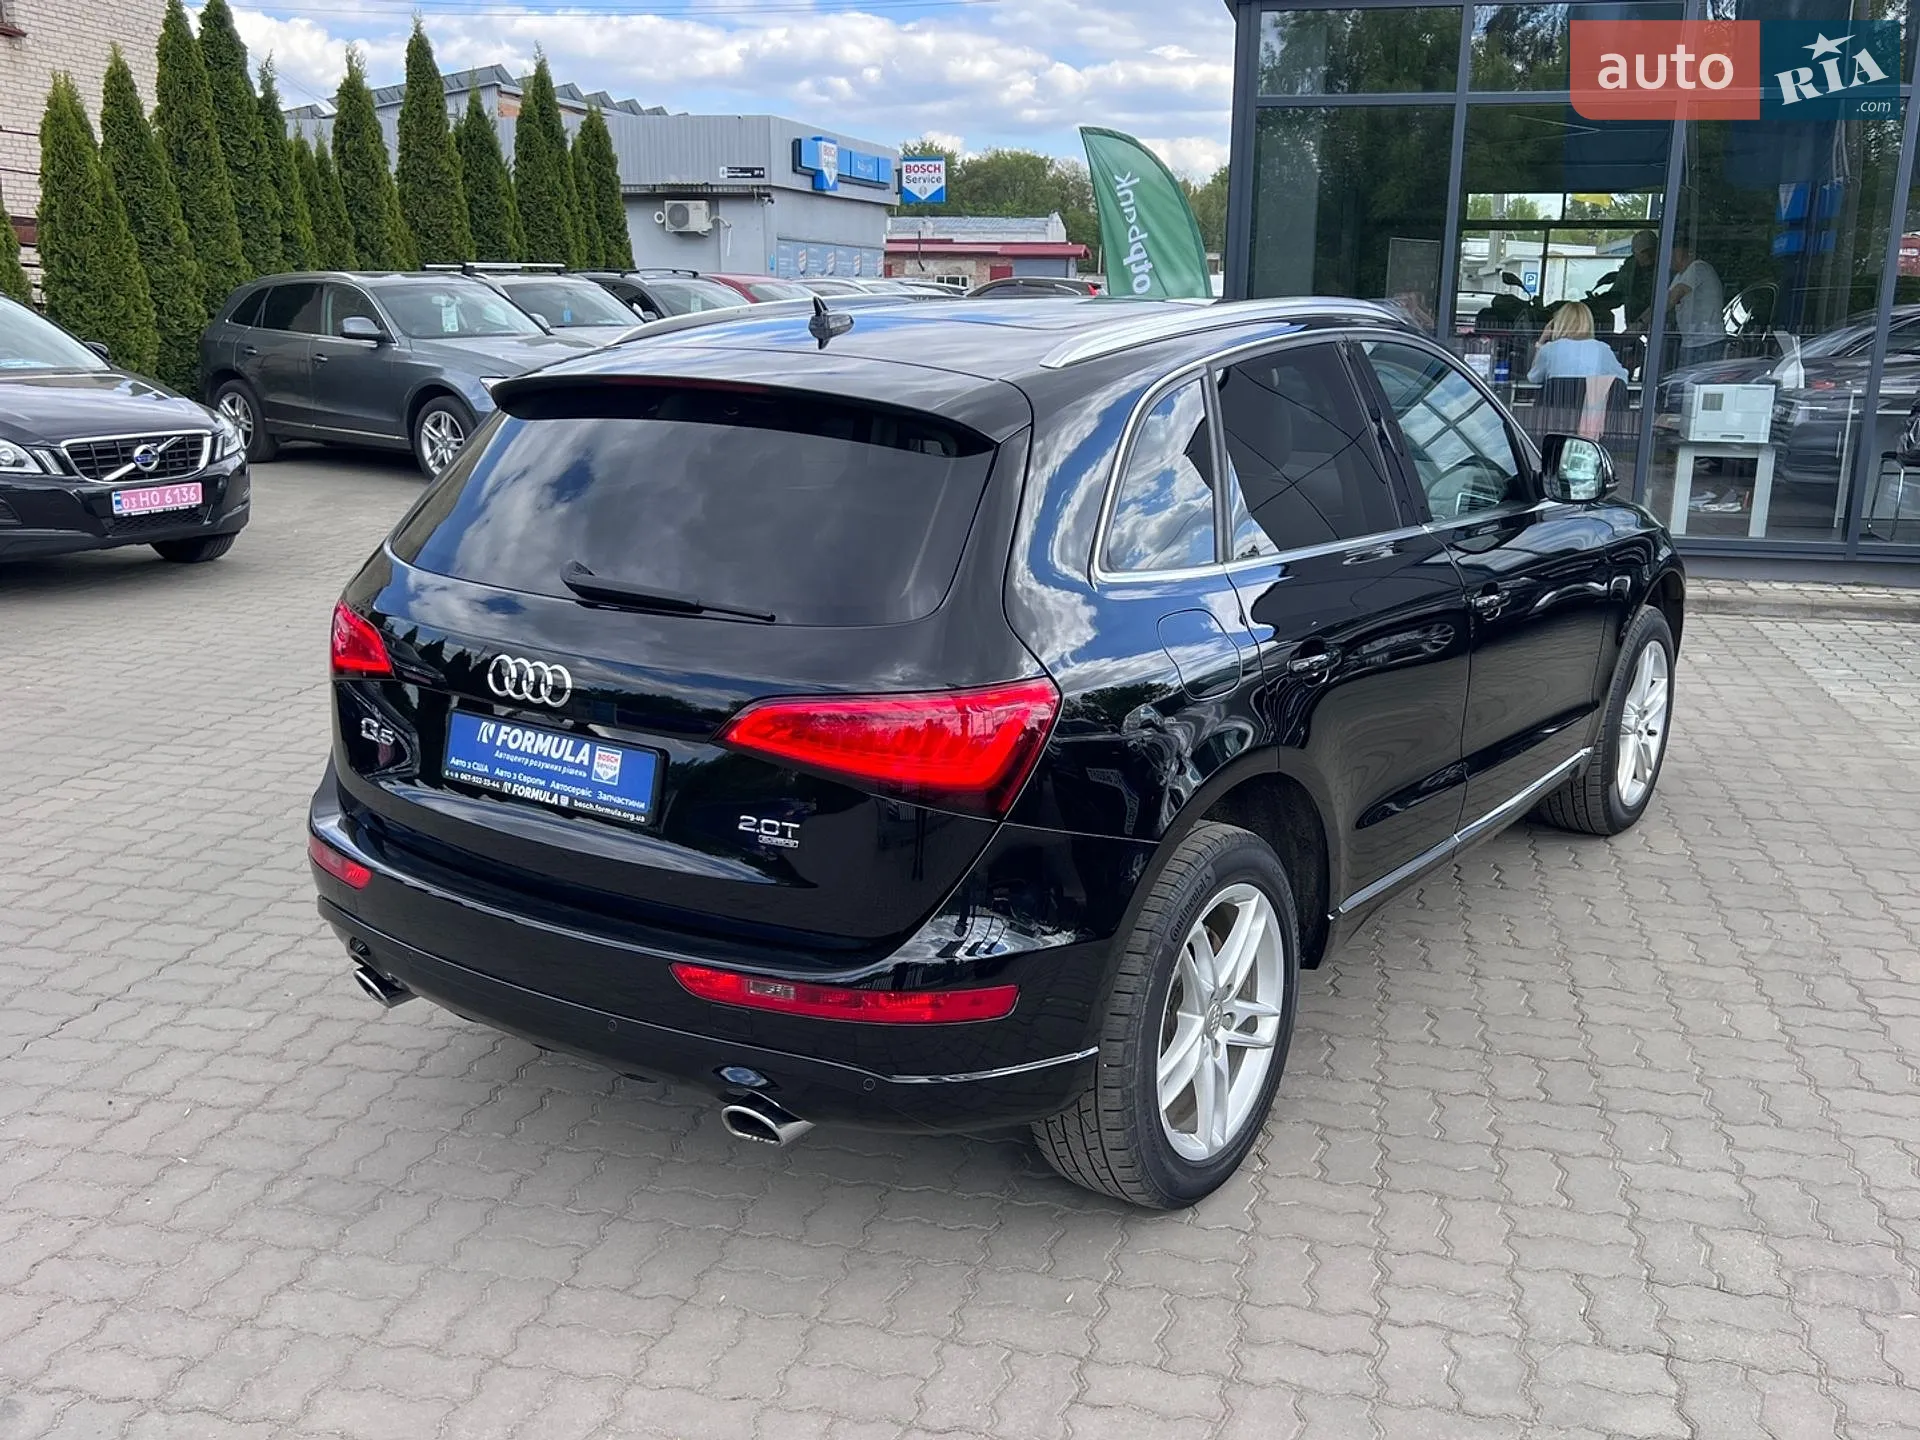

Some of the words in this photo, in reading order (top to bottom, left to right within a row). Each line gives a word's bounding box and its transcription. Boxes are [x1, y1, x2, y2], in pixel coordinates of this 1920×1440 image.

[905, 164, 941, 174] BOSCH
[905, 174, 942, 184] Service
[122, 497, 138, 509] 03
[164, 486, 197, 504] 6136
[361, 717, 395, 746] Q5
[496, 725, 591, 766] FORMULA
[597, 752, 619, 764] BOSCH
[450, 756, 467, 768] Авто
[494, 767, 512, 779] Авто
[518, 772, 546, 787] Європи
[549, 780, 593, 798] Автосервіс
[597, 790, 646, 810] Запчастини
[511, 783, 559, 805] FORMULA
[738, 815, 800, 839] 2.0T
[1169, 879, 1207, 943] Continental
